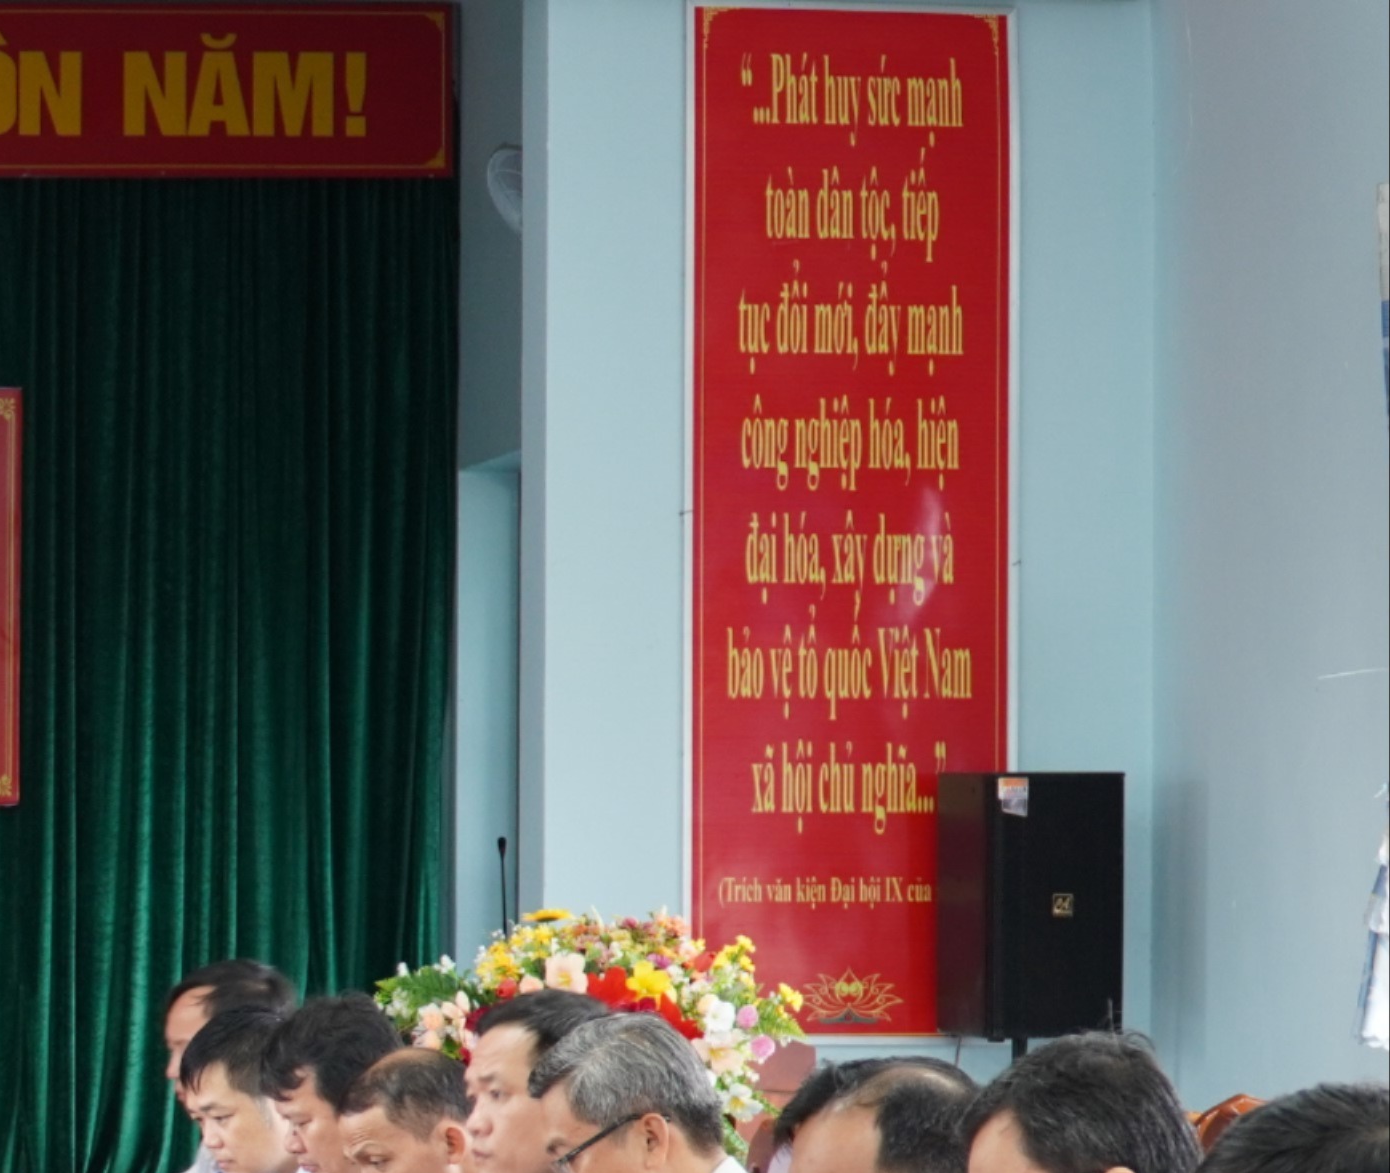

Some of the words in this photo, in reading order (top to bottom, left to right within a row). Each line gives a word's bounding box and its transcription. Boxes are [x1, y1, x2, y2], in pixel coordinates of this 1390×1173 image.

[123, 34, 368, 138] NĂM!
[824, 54, 860, 146] huy
[868, 54, 900, 126] sức
[907, 57, 963, 147] mạnh
[766, 166, 809, 238] toàn
[817, 166, 854, 239] dân
[860, 166, 896, 261] tộc,
[902, 148, 940, 262] tiếp
[739, 289, 770, 374] tục
[777, 259, 808, 354] đổi
[814, 282, 858, 371] mới,
[865, 261, 900, 376] đẩy
[907, 285, 963, 376] mạnh
[742, 394, 788, 491] công
[795, 394, 862, 491] nghiệp
[869, 397, 911, 487] hóa,
[917, 395, 959, 491] hiện
[746, 512, 777, 604] đại
[784, 511, 826, 600] hóa,
[832, 510, 867, 603] xây
[873, 513, 925, 606] dựng
[930, 512, 954, 584] và
[728, 626, 764, 699] bảo
[770, 625, 792, 719] vệ
[798, 604, 818, 699] tổ
[824, 608, 872, 720] quốc
[878, 624, 919, 719] Việt
[924, 627, 972, 699] Nam
[752, 744, 774, 813] xã
[782, 739, 813, 833] hội
[819, 741, 854, 813] chủ
[719, 877, 762, 907] (Trích
[767, 877, 791, 902] văn
[796, 876, 826, 909] kiện
[831, 876, 855, 909] Đại
[859, 876, 880, 909] hội
[886, 877, 904, 902] IX
